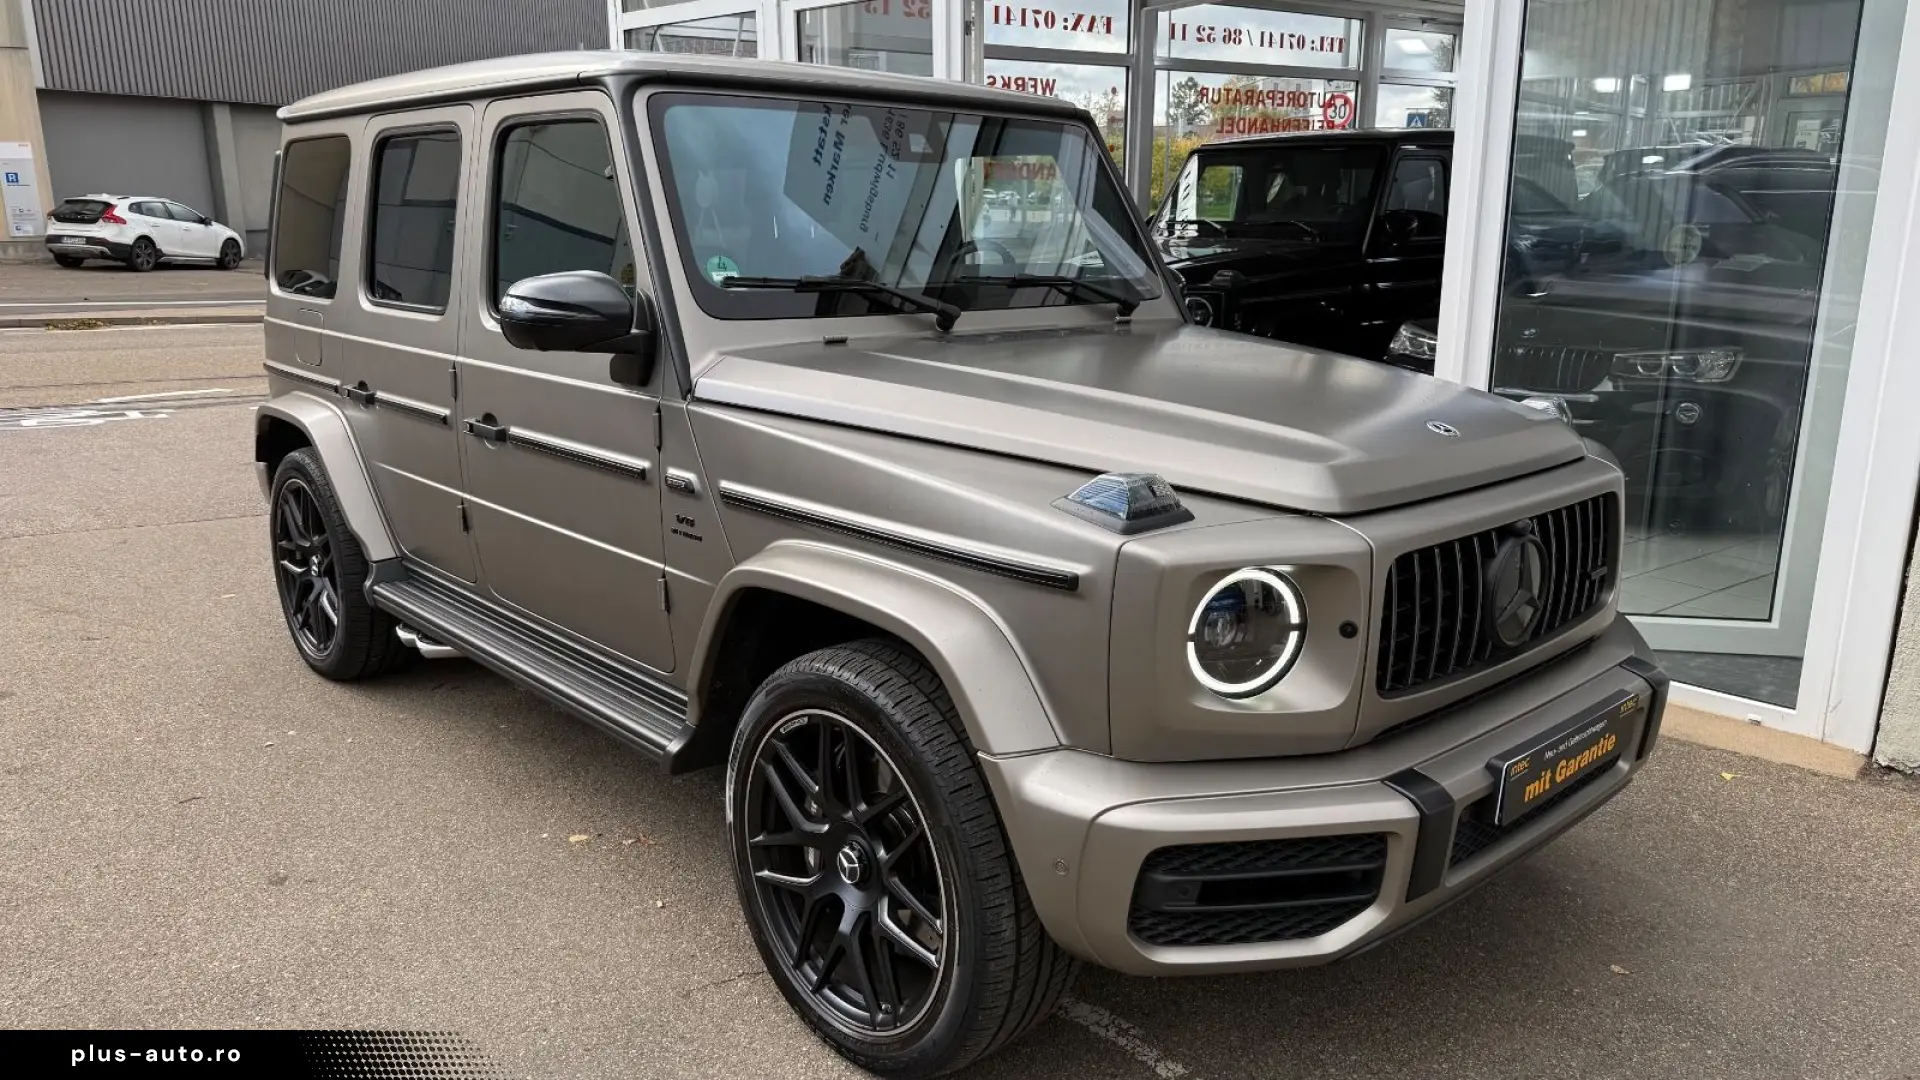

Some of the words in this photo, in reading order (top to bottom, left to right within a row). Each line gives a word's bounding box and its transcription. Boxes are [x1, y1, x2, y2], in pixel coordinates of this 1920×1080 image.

[1329, 104, 1346, 119] 30
[1524, 768, 1552, 802] mit
[1555, 733, 1616, 784] Garantie
